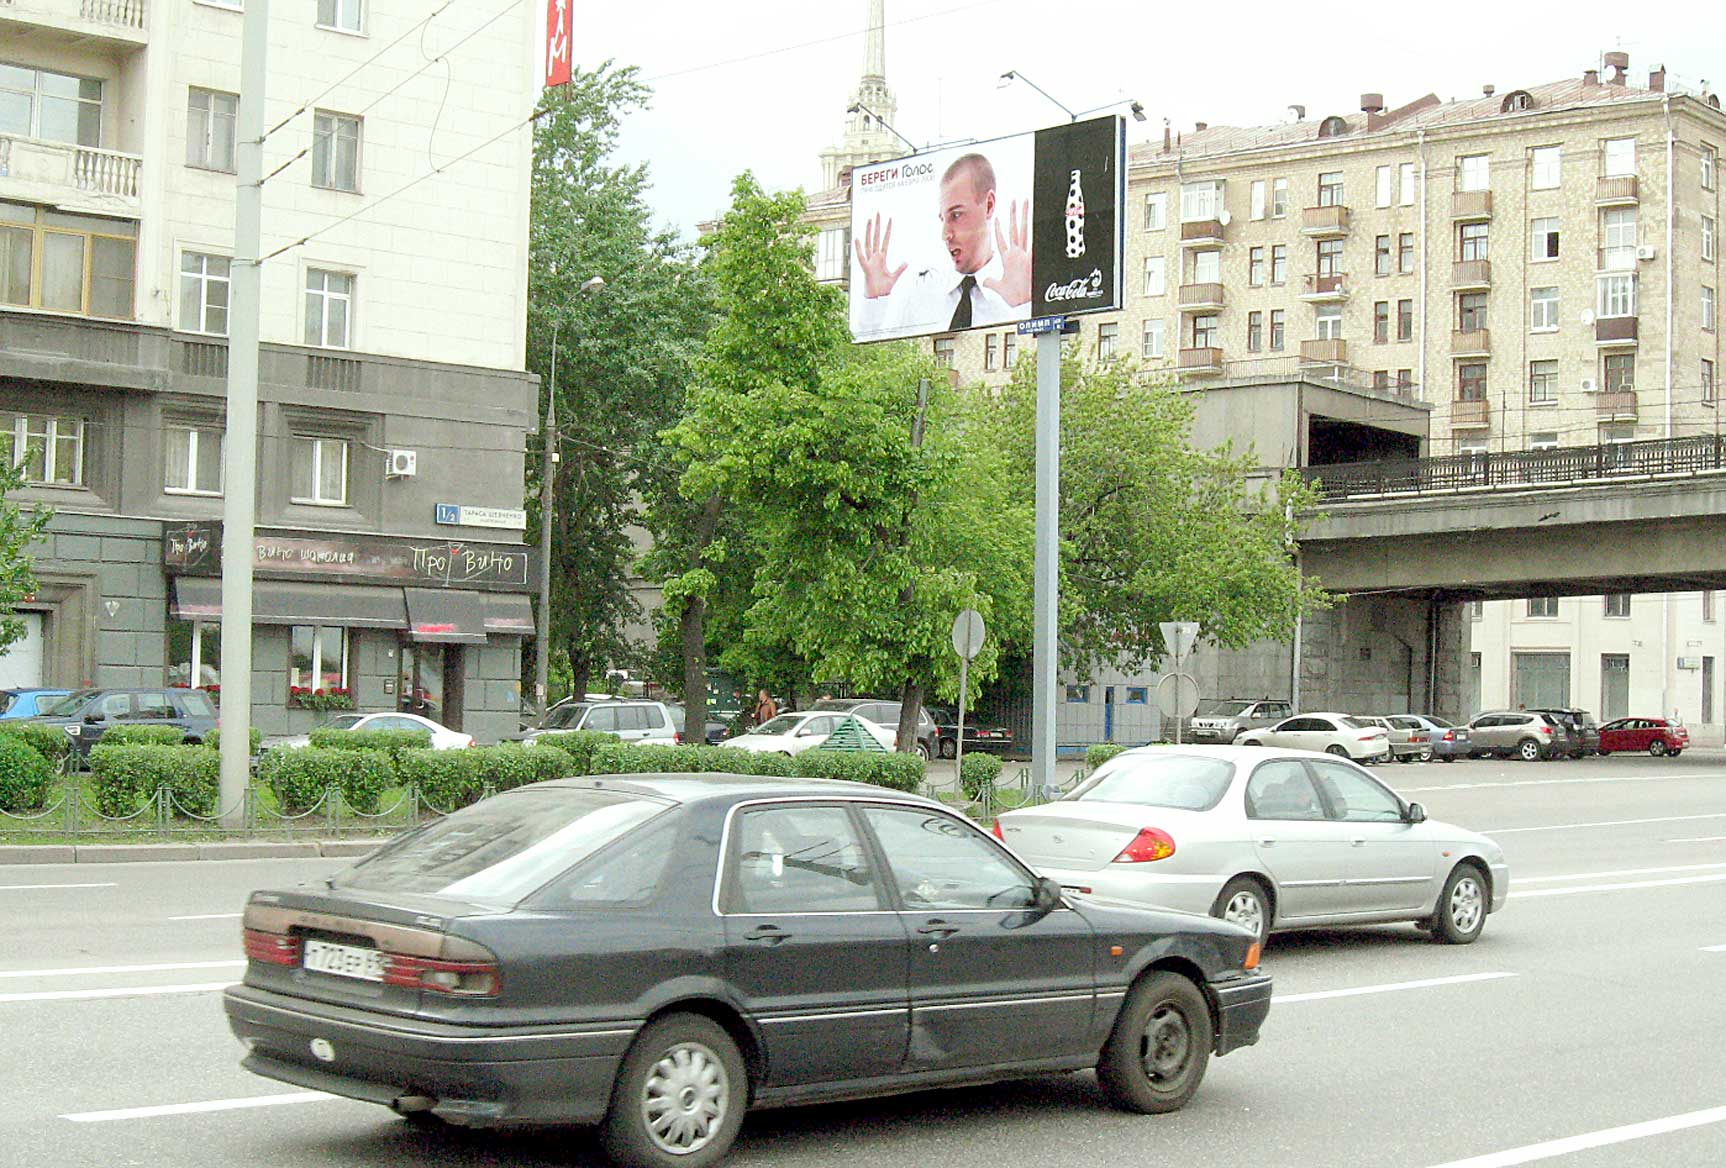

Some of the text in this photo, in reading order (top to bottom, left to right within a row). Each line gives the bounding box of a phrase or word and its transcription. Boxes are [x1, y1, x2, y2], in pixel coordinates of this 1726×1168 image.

[861, 168, 898, 186] БЕРЕГИ
[410, 546, 513, 576] Про Вино
